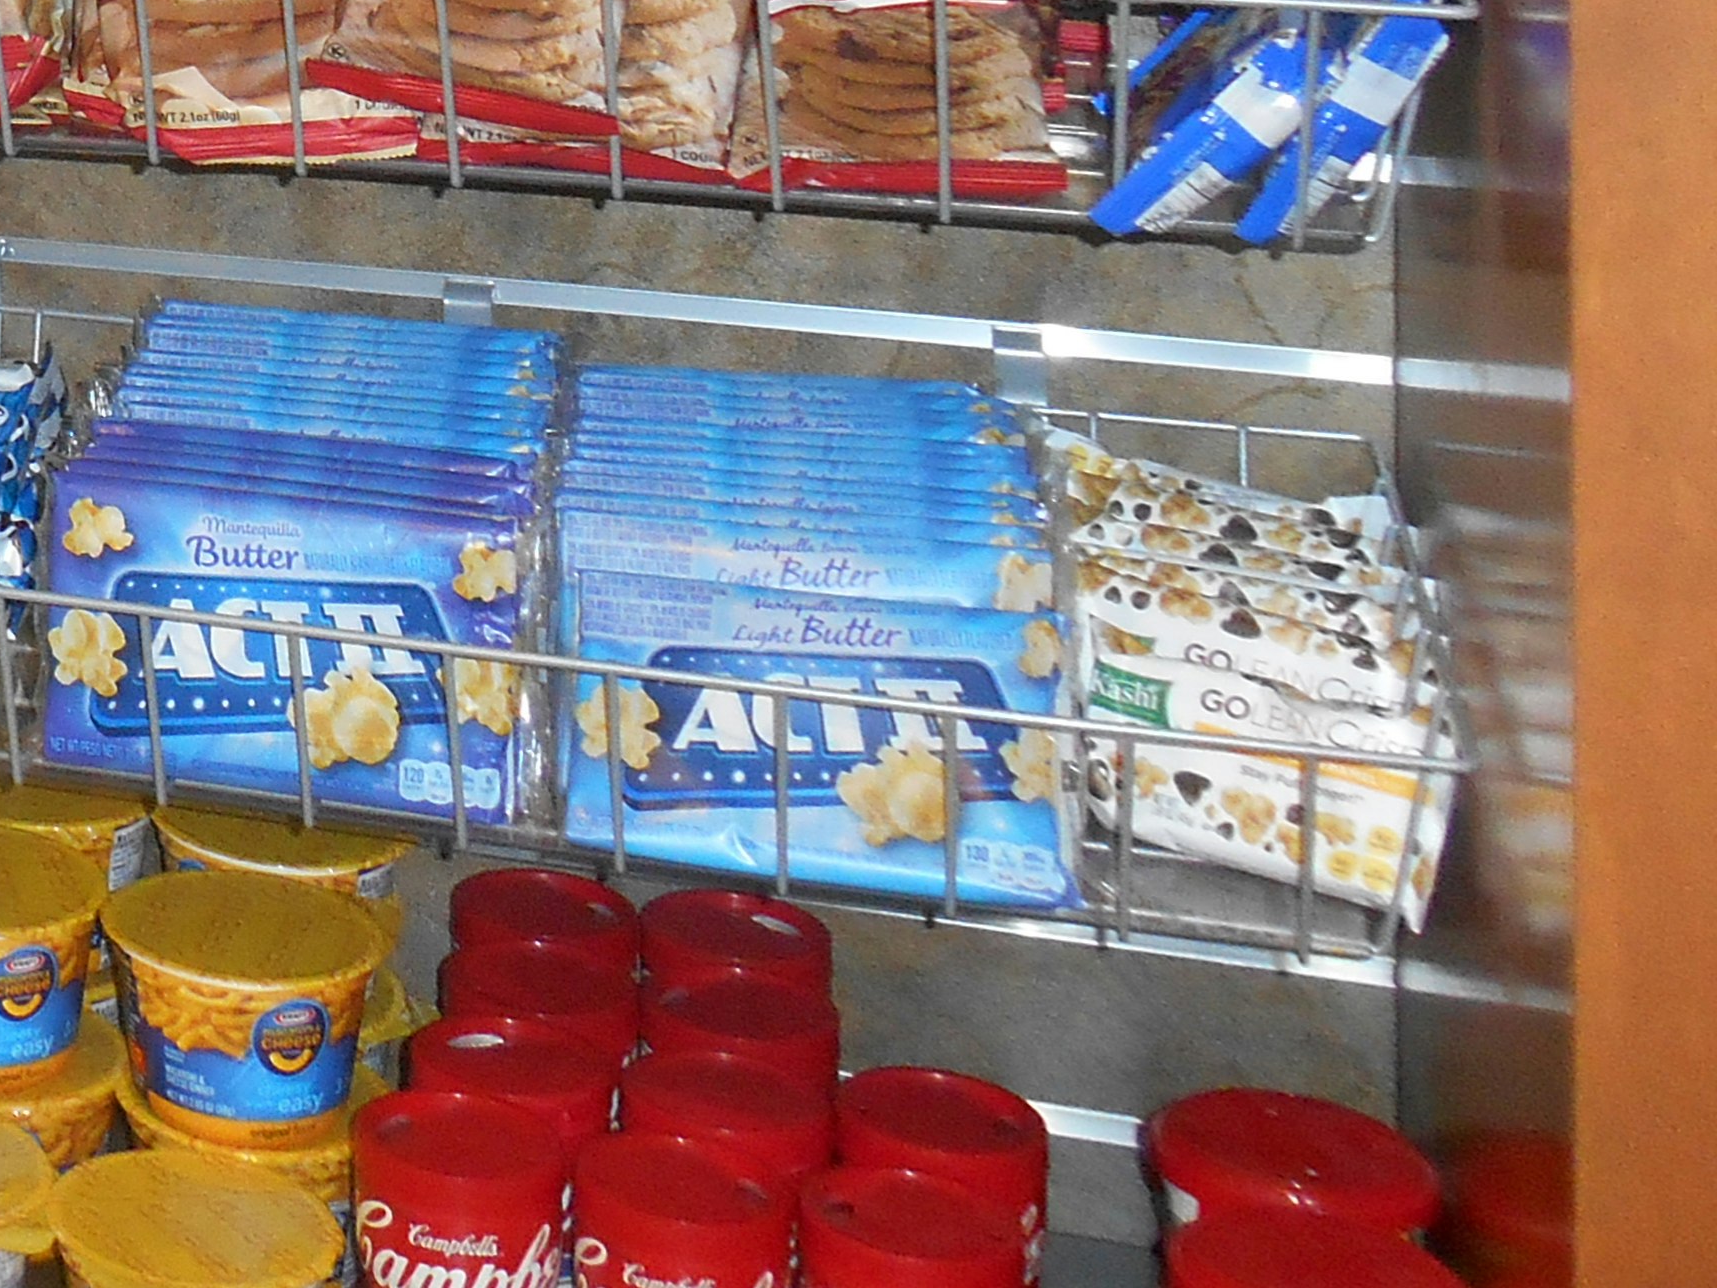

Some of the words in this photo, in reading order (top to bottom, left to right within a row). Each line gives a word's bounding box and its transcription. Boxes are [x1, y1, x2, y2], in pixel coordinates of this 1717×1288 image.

[179, 109, 210, 125] 2.1oz
[201, 516, 302, 541] Mantequilla
[185, 534, 299, 572] Butter
[778, 555, 880, 588] Butter
[139, 597, 315, 680] ACT
[732, 622, 797, 646] Light
[799, 615, 902, 648] Butter
[671, 673, 865, 754] ACT
[403, 764, 425, 785] 120
[11, 1034, 55, 1059] easy
[277, 1092, 323, 1115] easy
[407, 1222, 500, 1258] Campbell's
